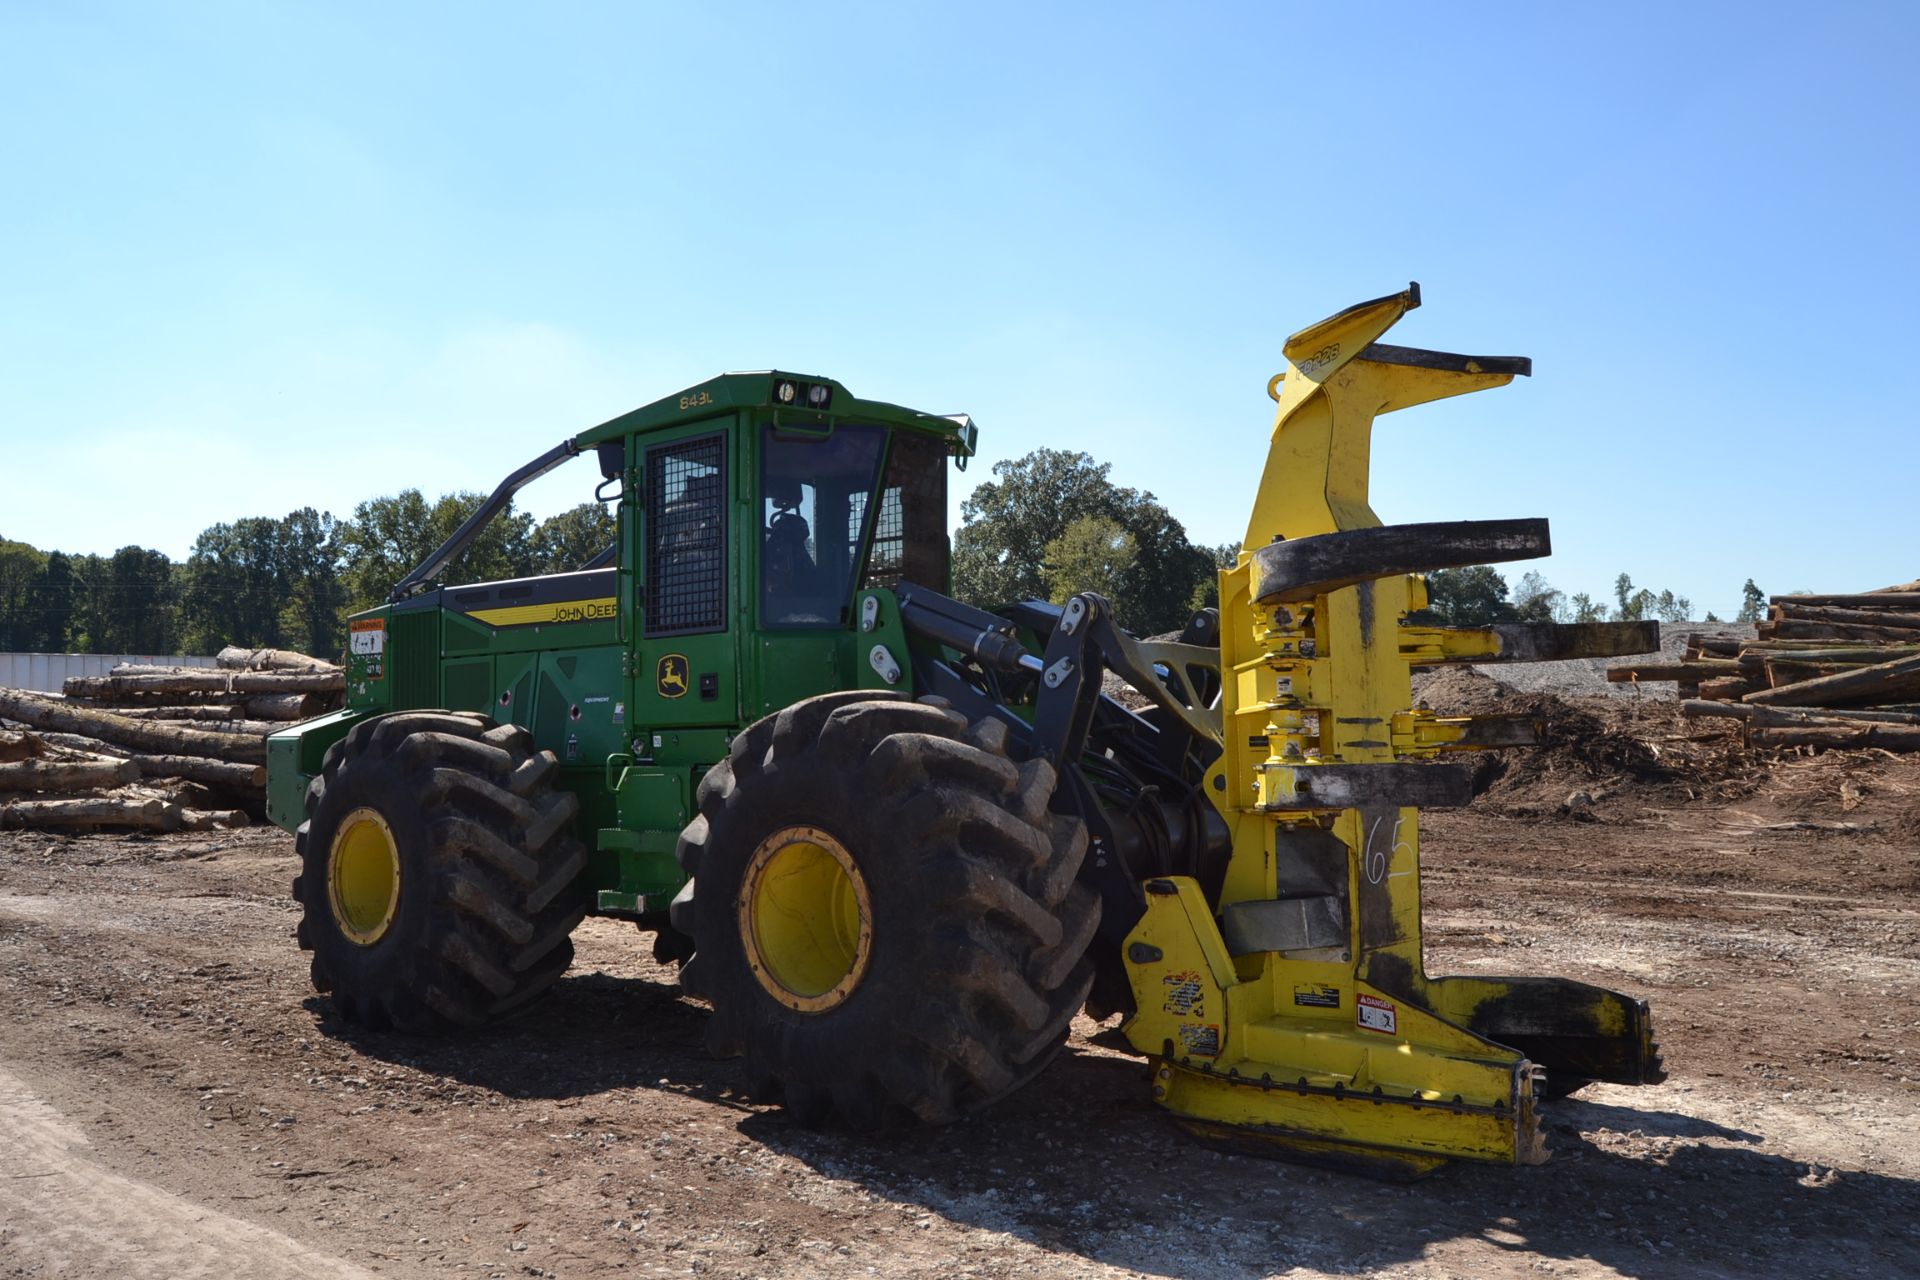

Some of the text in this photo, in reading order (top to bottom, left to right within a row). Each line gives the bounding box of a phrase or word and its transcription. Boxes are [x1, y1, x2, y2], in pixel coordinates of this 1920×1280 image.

[680, 392, 713, 410] 843L
[551, 606, 584, 621] JOHN
[1365, 815, 1414, 884] 65
[1366, 997, 1393, 1011] DANGER
